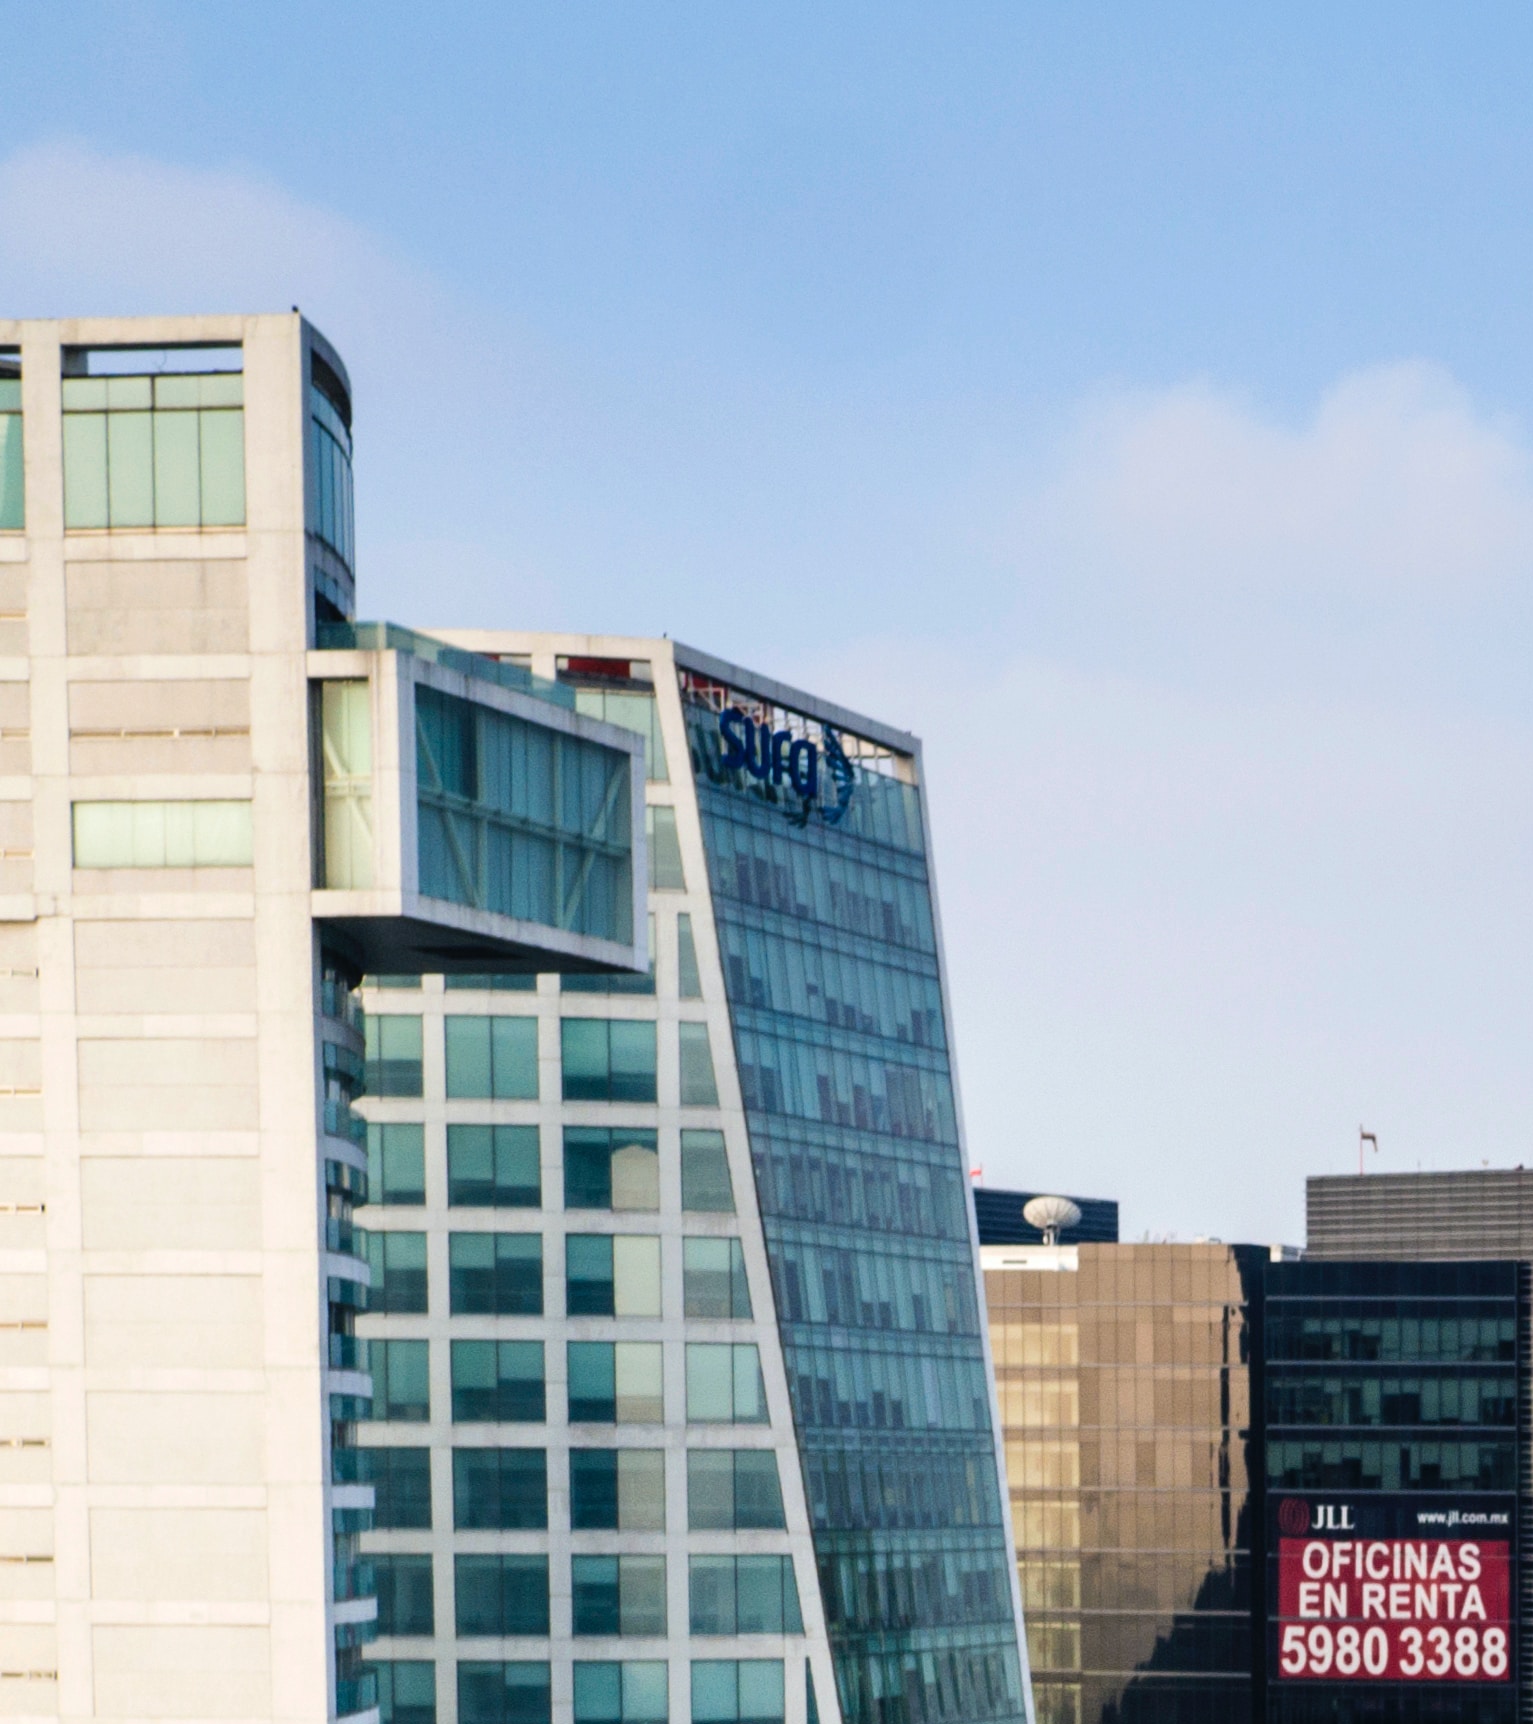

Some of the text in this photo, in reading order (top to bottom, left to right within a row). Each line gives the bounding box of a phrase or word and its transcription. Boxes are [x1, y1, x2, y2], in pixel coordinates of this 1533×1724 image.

[720, 706, 817, 799] sura
[1312, 1505, 1354, 1529] JLL
[1417, 1511, 1509, 1527] www.jll.com.mx
[1302, 1541, 1482, 1580] OFICINAS
[1299, 1583, 1487, 1620] EN RENTA
[1281, 1625, 1508, 1676] 5980 3388
